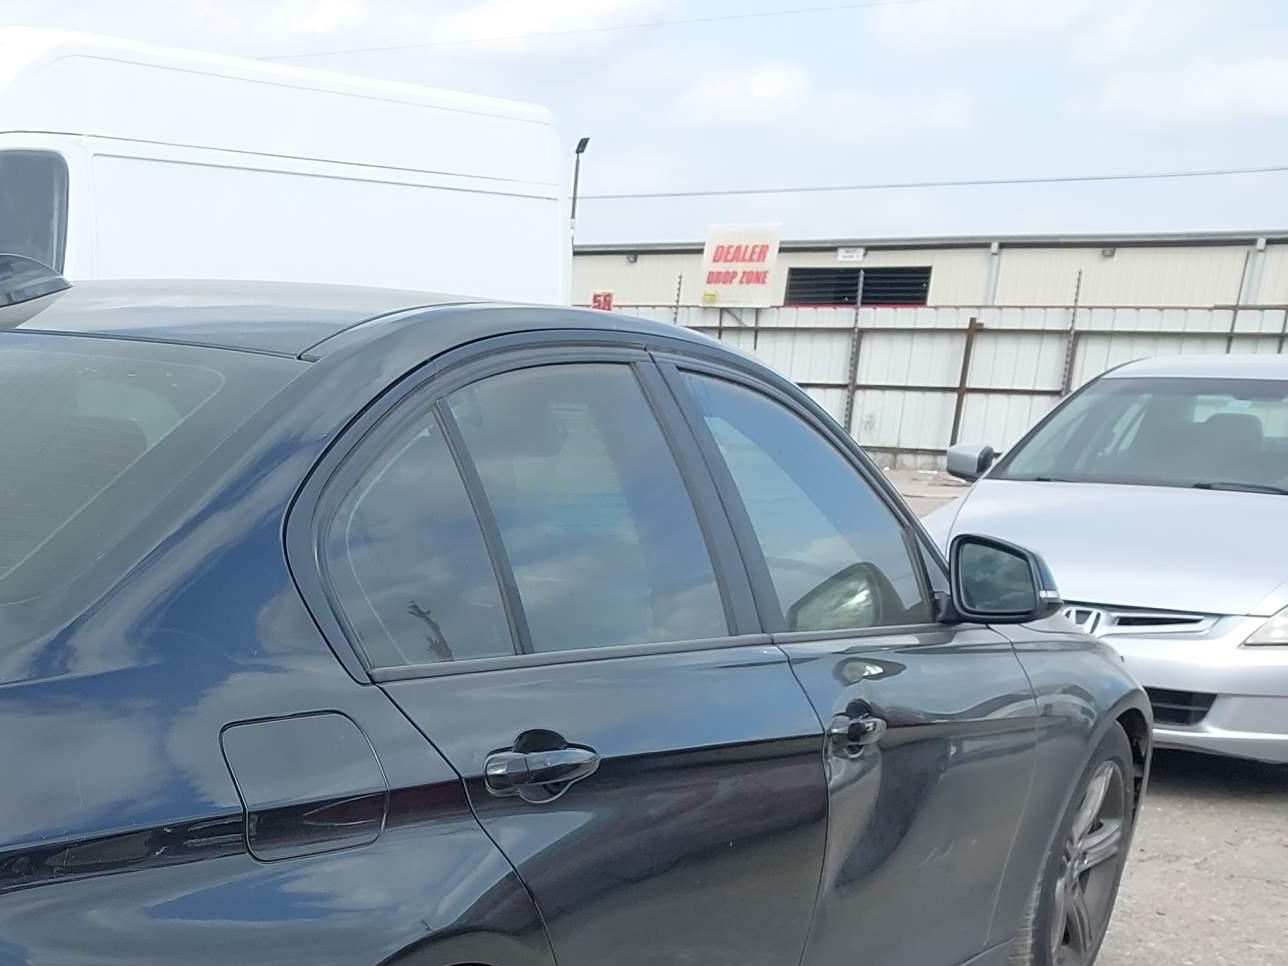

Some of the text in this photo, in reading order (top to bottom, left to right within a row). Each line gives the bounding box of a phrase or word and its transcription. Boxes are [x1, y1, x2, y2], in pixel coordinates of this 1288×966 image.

[711, 244, 770, 263] DEALER
[706, 270, 769, 285] DROP ZONE
